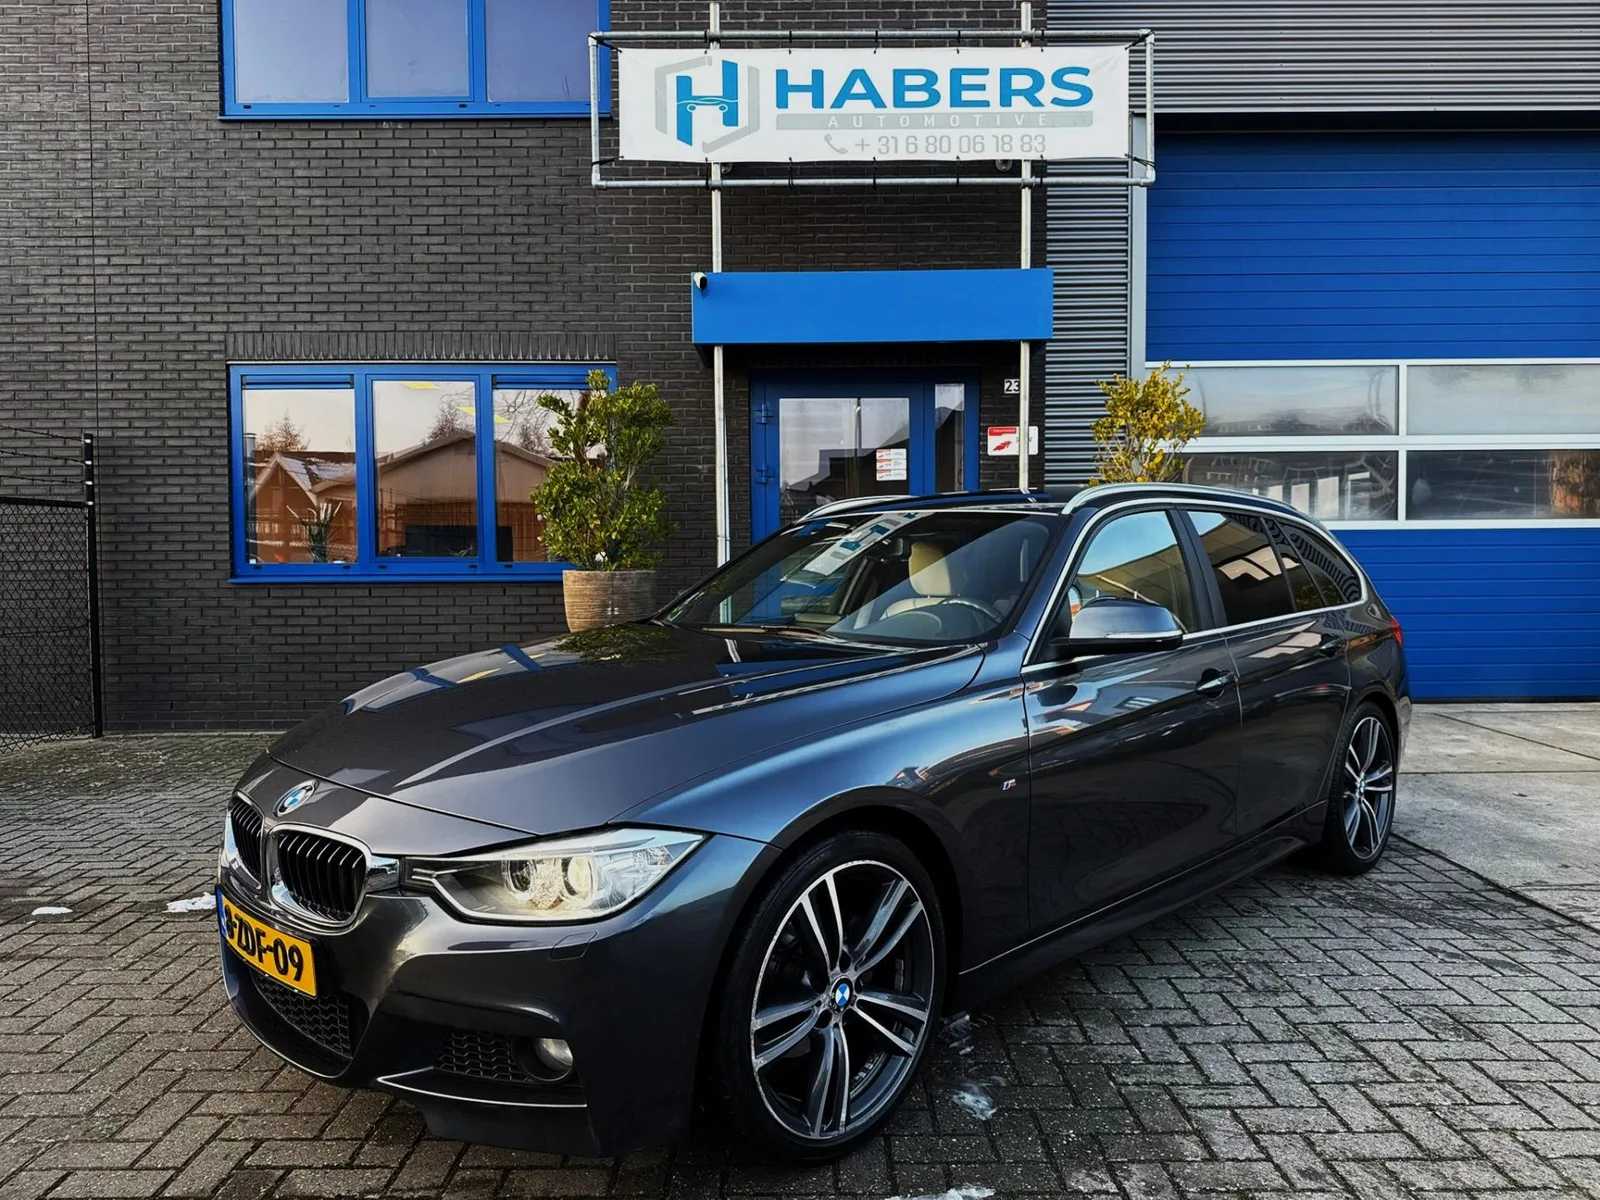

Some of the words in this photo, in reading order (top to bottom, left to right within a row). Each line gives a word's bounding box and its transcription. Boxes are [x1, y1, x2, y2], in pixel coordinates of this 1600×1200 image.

[775, 66, 1093, 109] HABERS
[828, 114, 1048, 128] AUTOMOTIVE
[1005, 380, 1020, 393] 23
